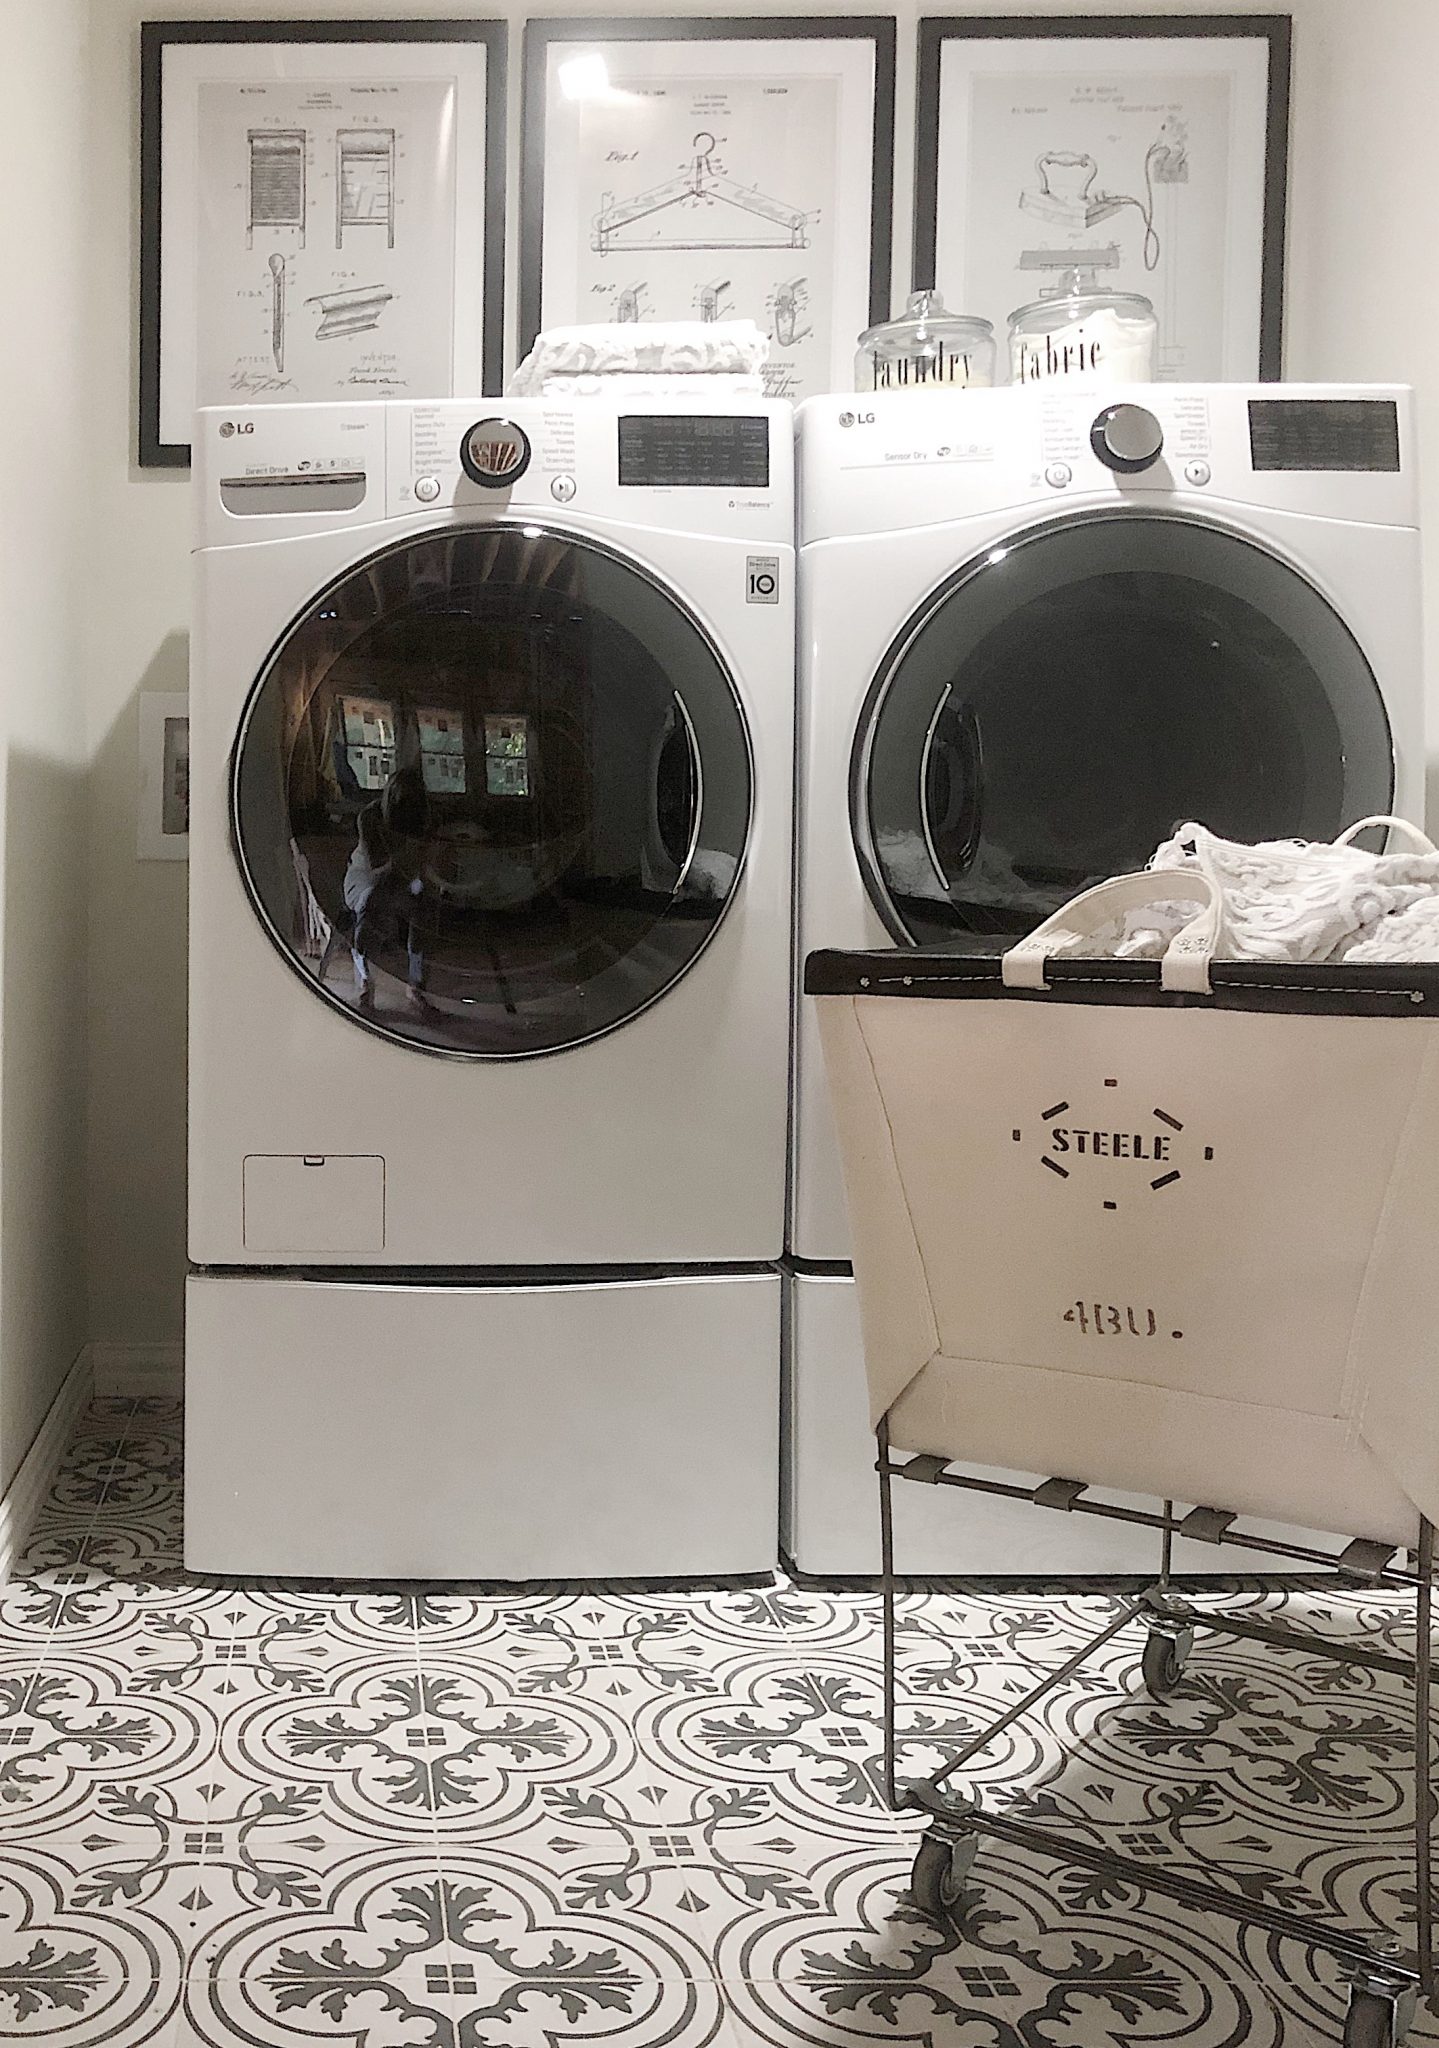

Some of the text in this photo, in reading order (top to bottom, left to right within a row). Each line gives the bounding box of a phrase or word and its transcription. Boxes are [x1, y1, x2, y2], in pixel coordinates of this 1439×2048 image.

[874, 341, 972, 391] laundry
[1020, 328, 1101, 385] fabric
[236, 422, 255, 435] LG
[857, 412, 876, 425] LG
[750, 574, 775, 594] 10
[1052, 1128, 1171, 1161] STEELE
